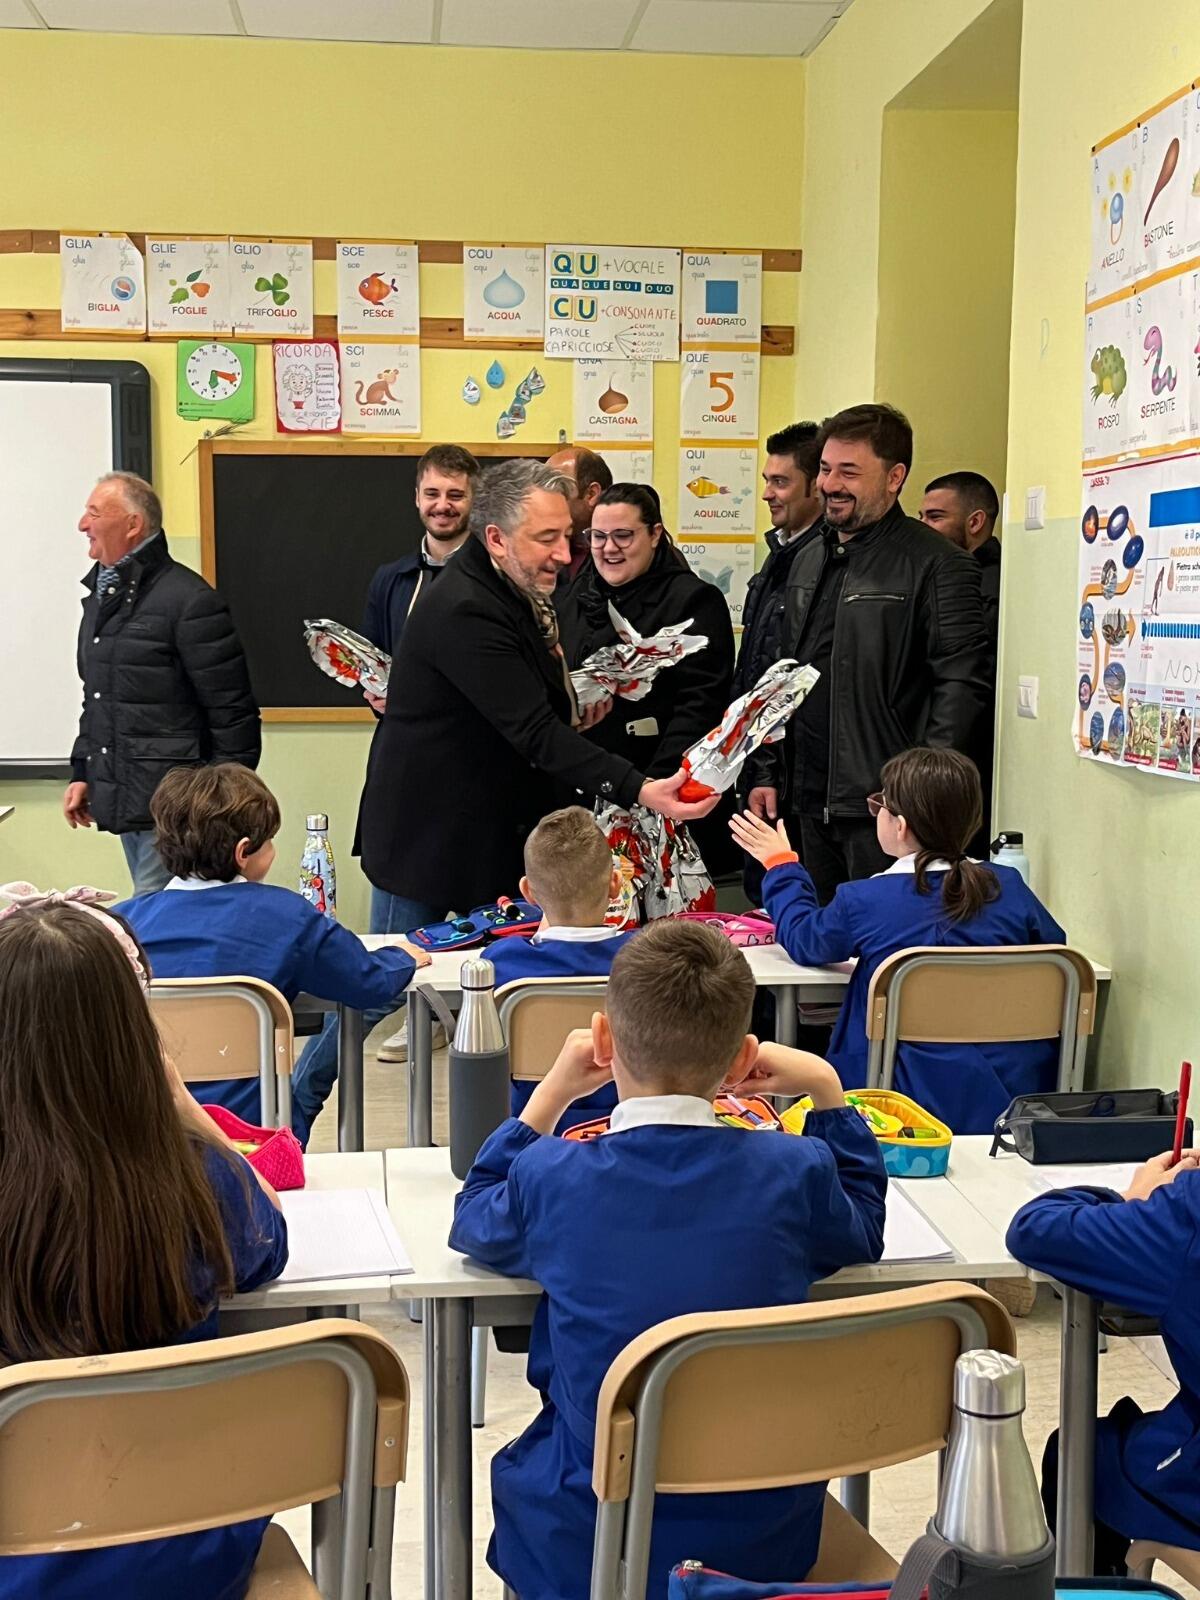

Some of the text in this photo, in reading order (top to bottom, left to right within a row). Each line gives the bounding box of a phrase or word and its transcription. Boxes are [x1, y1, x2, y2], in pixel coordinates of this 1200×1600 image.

[1143, 126, 1149, 143] B
[1144, 221, 1175, 248] BASTONE
[65, 238, 92, 249] GLIA
[151, 244, 176, 254] GLIE
[234, 245, 261, 255] GLIO
[342, 247, 365, 256] SCE
[468, 249, 493, 259] CQU
[687, 256, 711, 266] QUA
[1101, 248, 1125, 269] ANELLO
[554, 254, 596, 274] QU
[552, 280, 578, 288] QUA
[583, 281, 609, 289] QUE
[615, 281, 638, 290] QUI
[88, 303, 120, 312] BIGLIA
[172, 306, 208, 315] FOGLIE
[554, 298, 595, 319] CU
[1136, 297, 1142, 314] S
[246, 308, 297, 318] TRIFOGLIO
[363, 309, 394, 318] PESCE
[488, 312, 521, 320] ACQUA
[696, 317, 747, 326] QUADRATO
[550, 327, 590, 338] PAROLE
[273, 345, 332, 358] RICORDA
[345, 345, 364, 356] SCI
[545, 341, 615, 353] CAPRICCIOSE
[686, 354, 709, 363] QUE
[709, 372, 735, 413] 5
[360, 408, 401, 416] SCIMMIA
[1140, 397, 1176, 419] SERPENTE
[589, 416, 638, 425] CASTAGNA
[702, 414, 737, 423] CINQUE
[1098, 413, 1120, 430] ROSPO
[686, 450, 705, 460] QUI
[693, 510, 740, 518] AQUILONE
[682, 545, 706, 554] QUO
